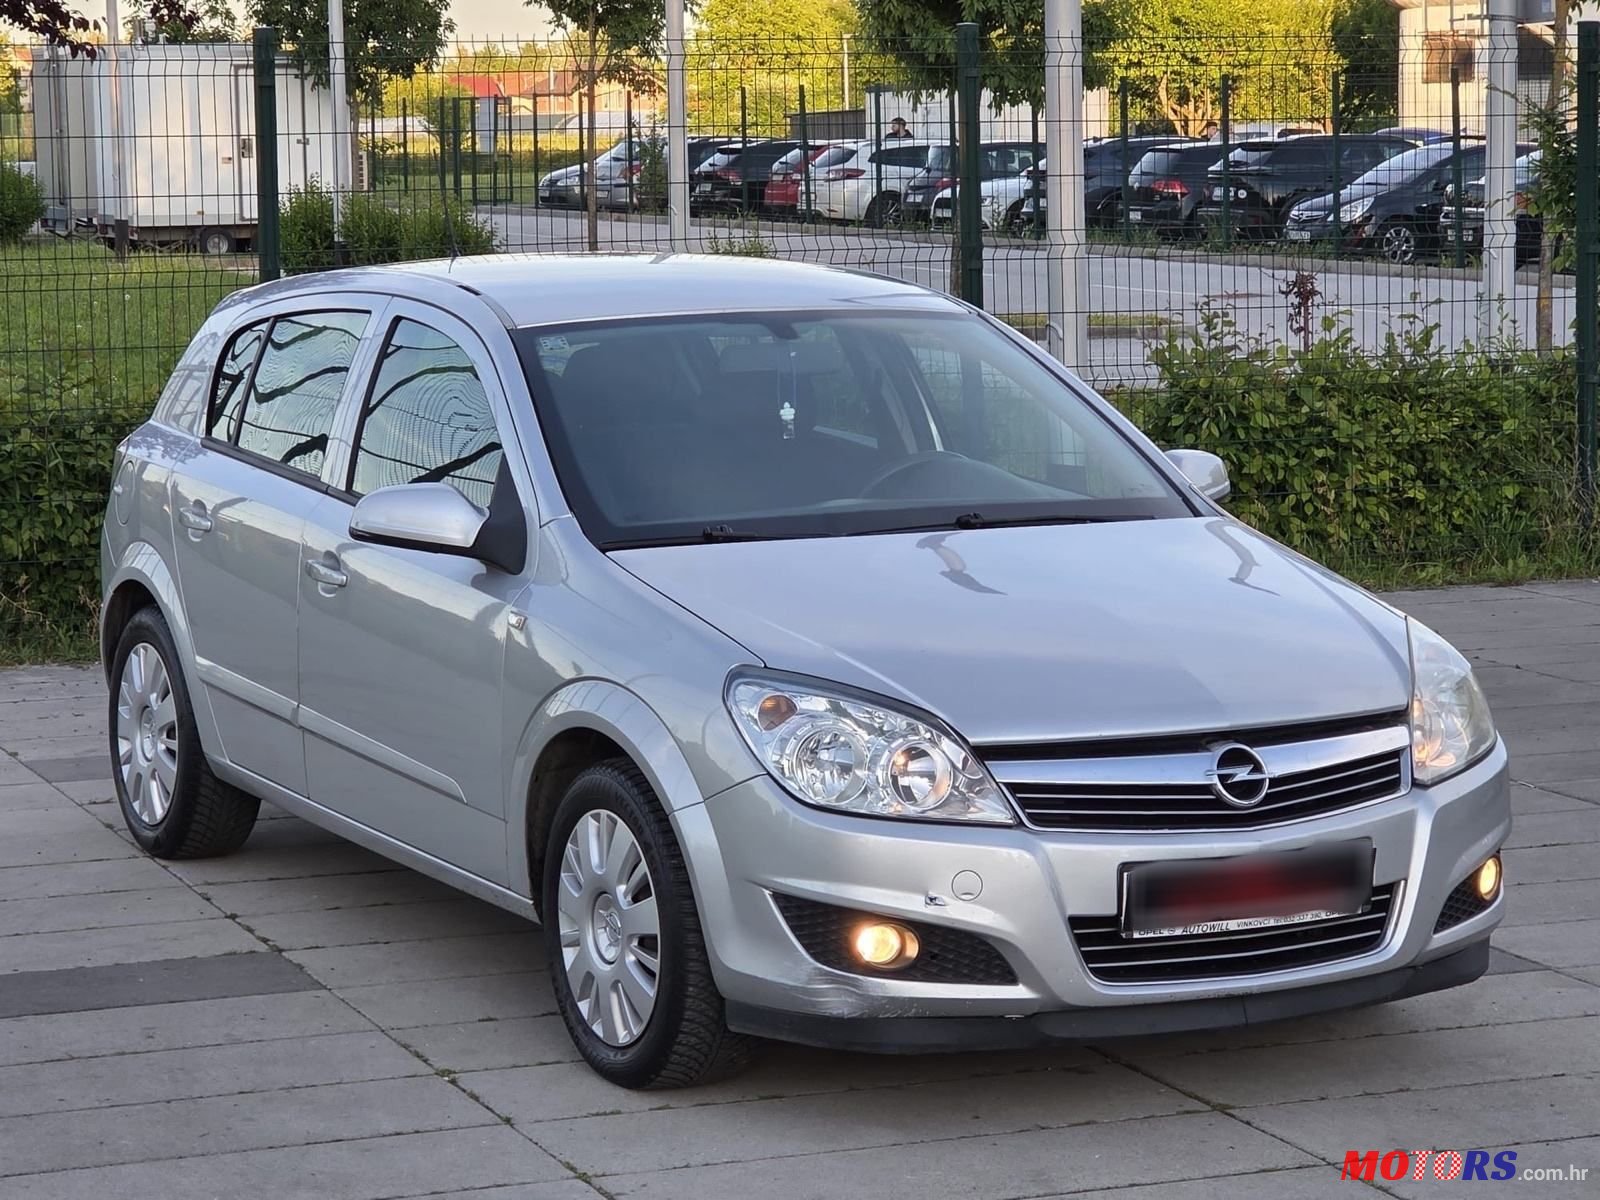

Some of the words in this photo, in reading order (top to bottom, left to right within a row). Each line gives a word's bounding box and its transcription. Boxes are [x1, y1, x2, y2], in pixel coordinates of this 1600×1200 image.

[1138, 927, 1164, 936] OPEL
[1181, 922, 1231, 935] AUTOWILL
[1237, 918, 1270, 928] VINKOVCI
